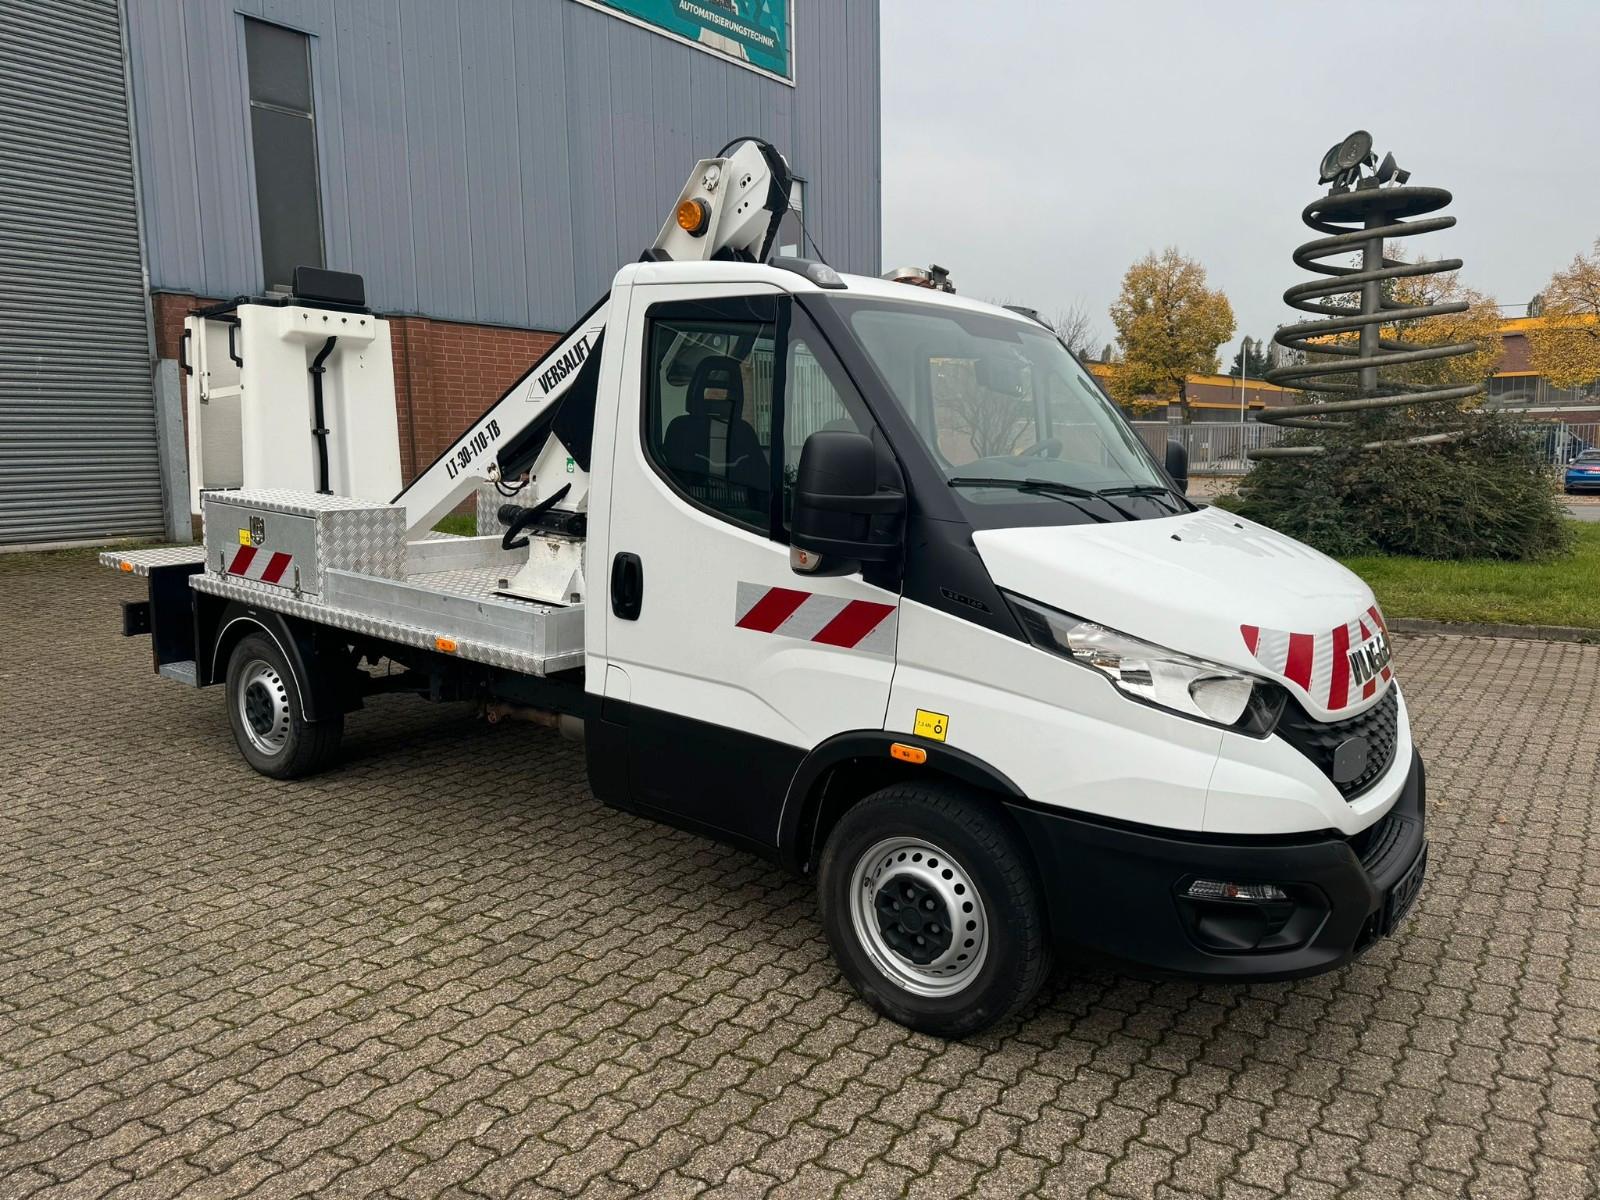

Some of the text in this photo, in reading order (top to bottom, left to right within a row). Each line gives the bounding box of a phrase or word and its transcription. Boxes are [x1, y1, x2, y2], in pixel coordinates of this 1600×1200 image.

[679, 0, 775, 48] AUTOMATISIERUNGSTECHNIK
[538, 335, 591, 395] VERSALIFT
[445, 419, 501, 480] LT-30-110-TB
